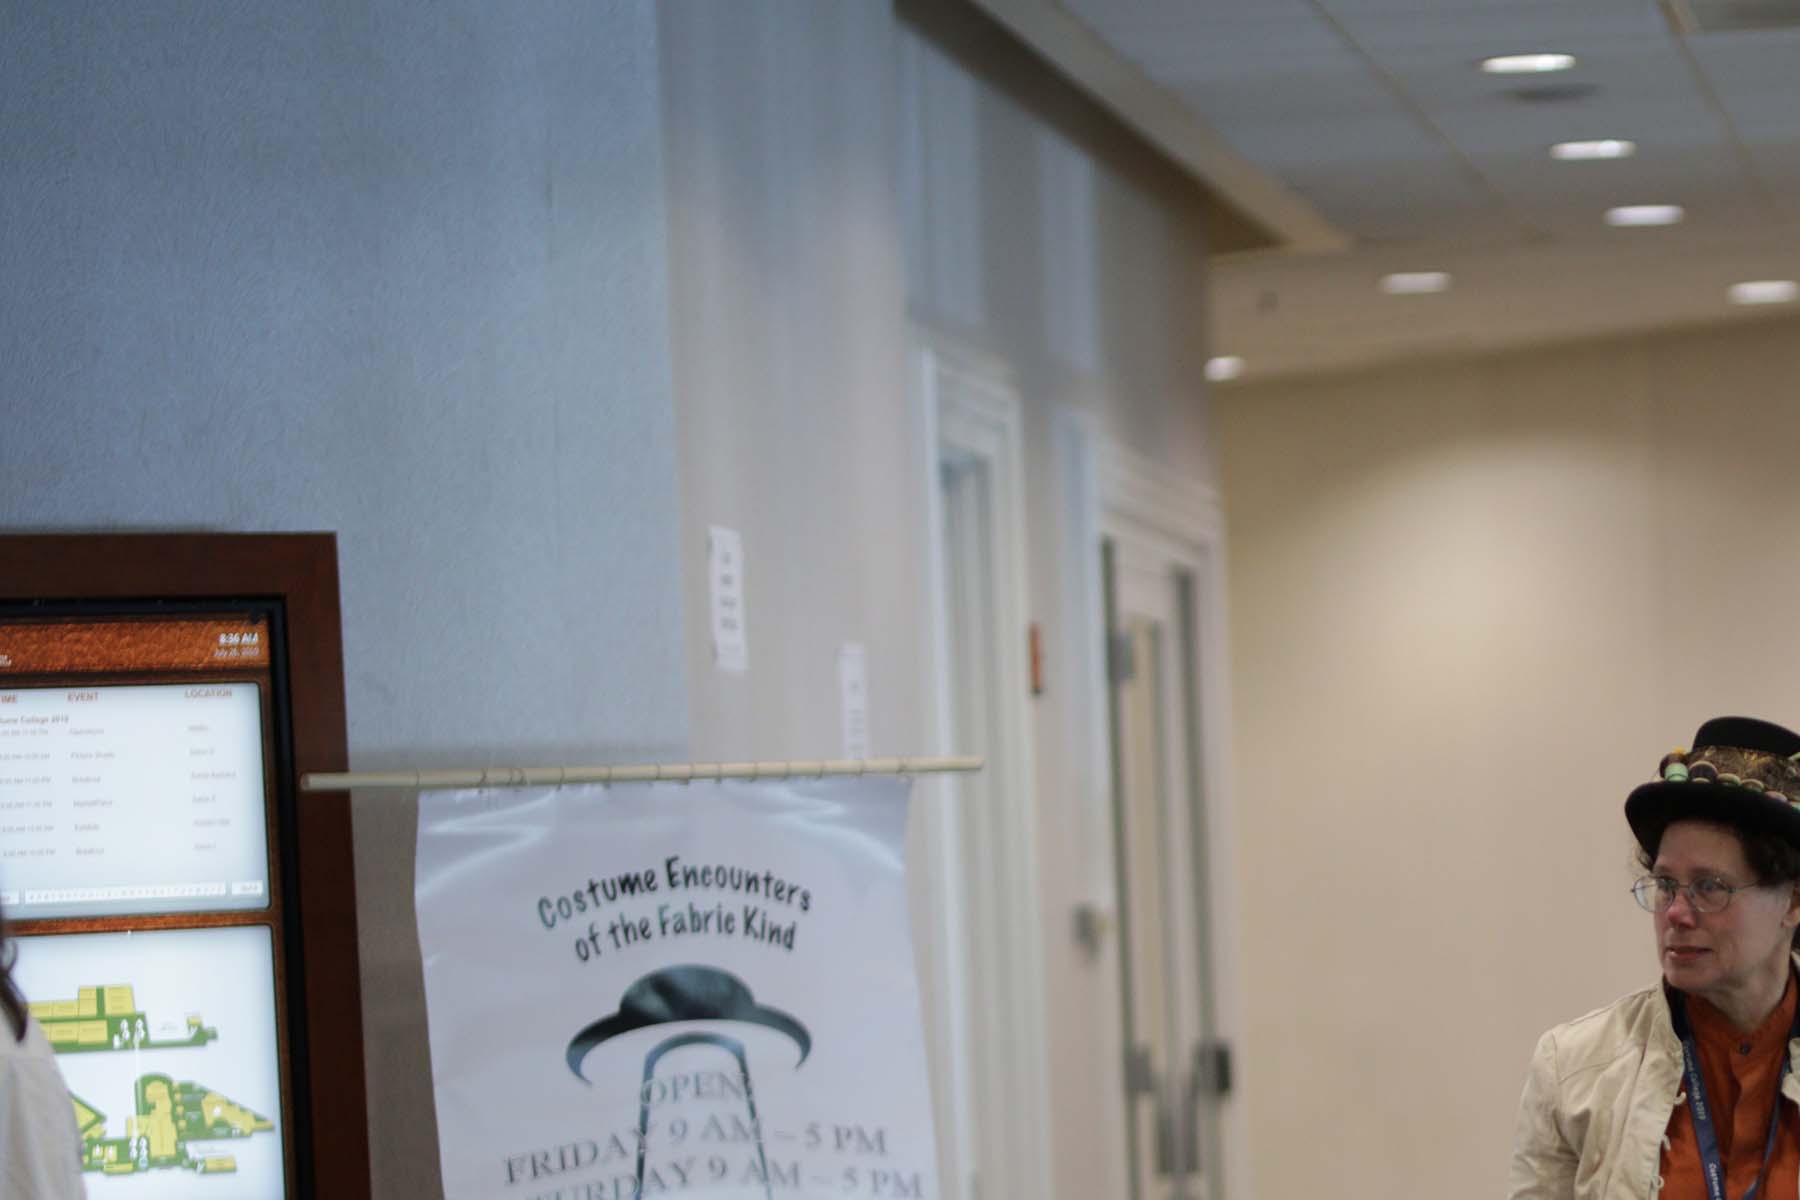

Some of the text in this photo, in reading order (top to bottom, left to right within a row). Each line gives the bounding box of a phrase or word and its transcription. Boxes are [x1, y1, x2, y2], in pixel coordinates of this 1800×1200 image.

[0, 694, 17, 703] IME
[67, 692, 99, 702] EVENT
[185, 688, 232, 698] LOCATION
[537, 855, 811, 929] Costume Encounters
[575, 902, 797, 963] of the Fabric Kind
[504, 1126, 656, 1186] FRIDAY
[668, 1117, 689, 1144] 9
[700, 1113, 763, 1144] AM
[804, 1121, 824, 1149] 5
[832, 1122, 889, 1154] PM
[708, 1155, 729, 1182] 9
[740, 1157, 802, 1188] AM
[842, 1165, 861, 1195] 5
[868, 1167, 924, 1200] PM
